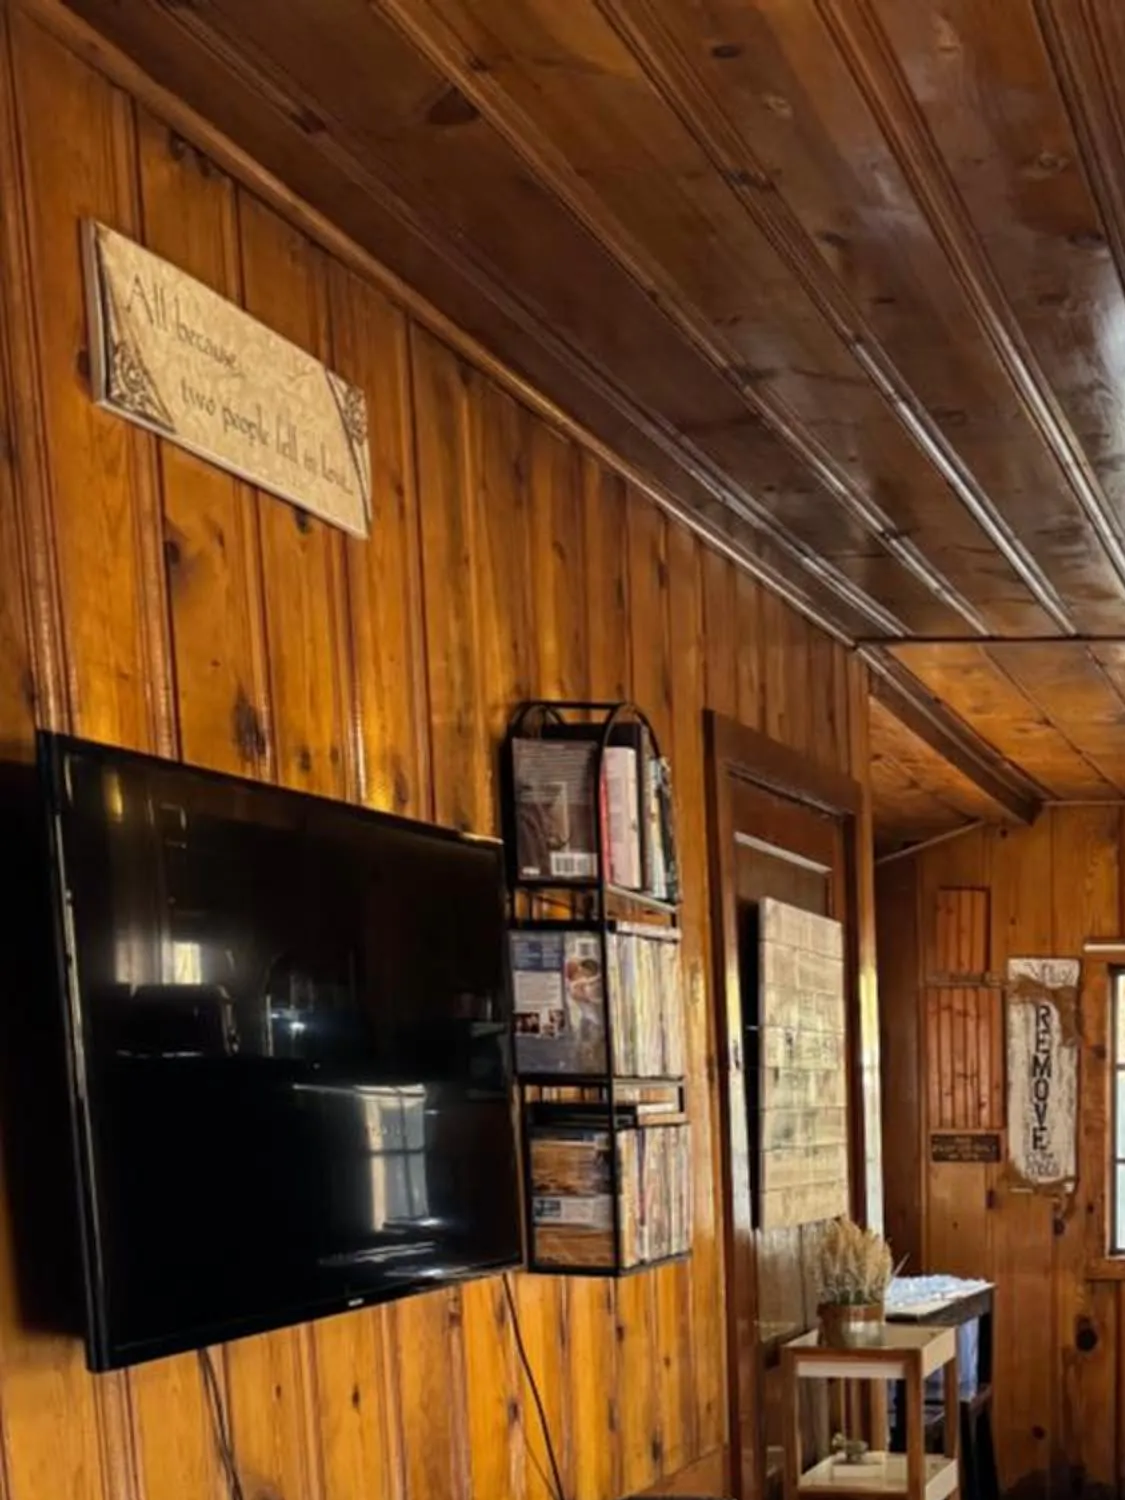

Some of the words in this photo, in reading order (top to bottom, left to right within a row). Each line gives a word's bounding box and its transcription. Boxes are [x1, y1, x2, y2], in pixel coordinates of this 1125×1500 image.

[126, 274, 168, 333] All
[181, 379, 216, 417] two
[222, 404, 271, 448] people
[1032, 1004, 1051, 1150] REMOVE
